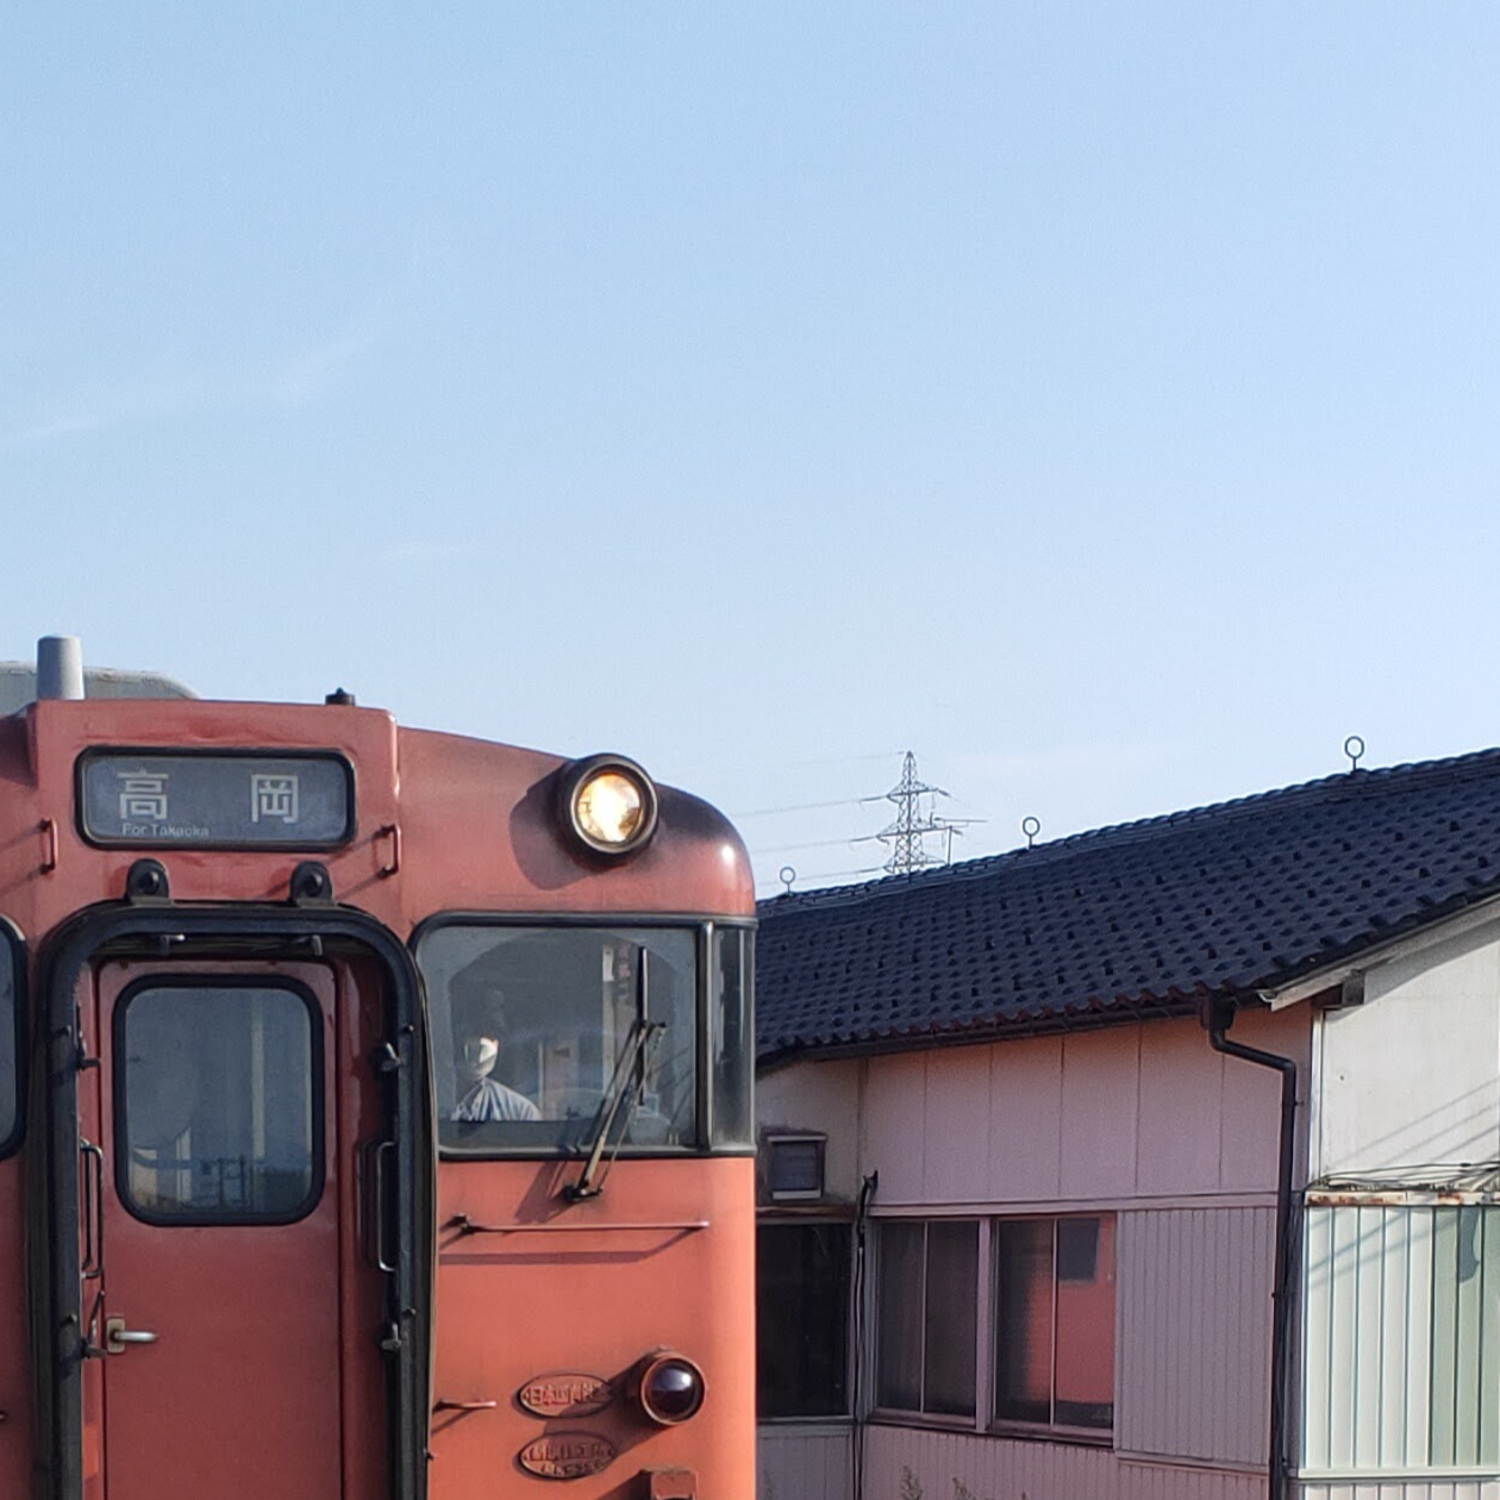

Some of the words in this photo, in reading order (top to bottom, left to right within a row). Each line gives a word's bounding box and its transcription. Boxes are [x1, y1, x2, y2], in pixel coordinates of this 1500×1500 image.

[116, 768, 300, 823] 高岡
[121, 823, 148, 836] For
[151, 824, 210, 837] Takaoka
